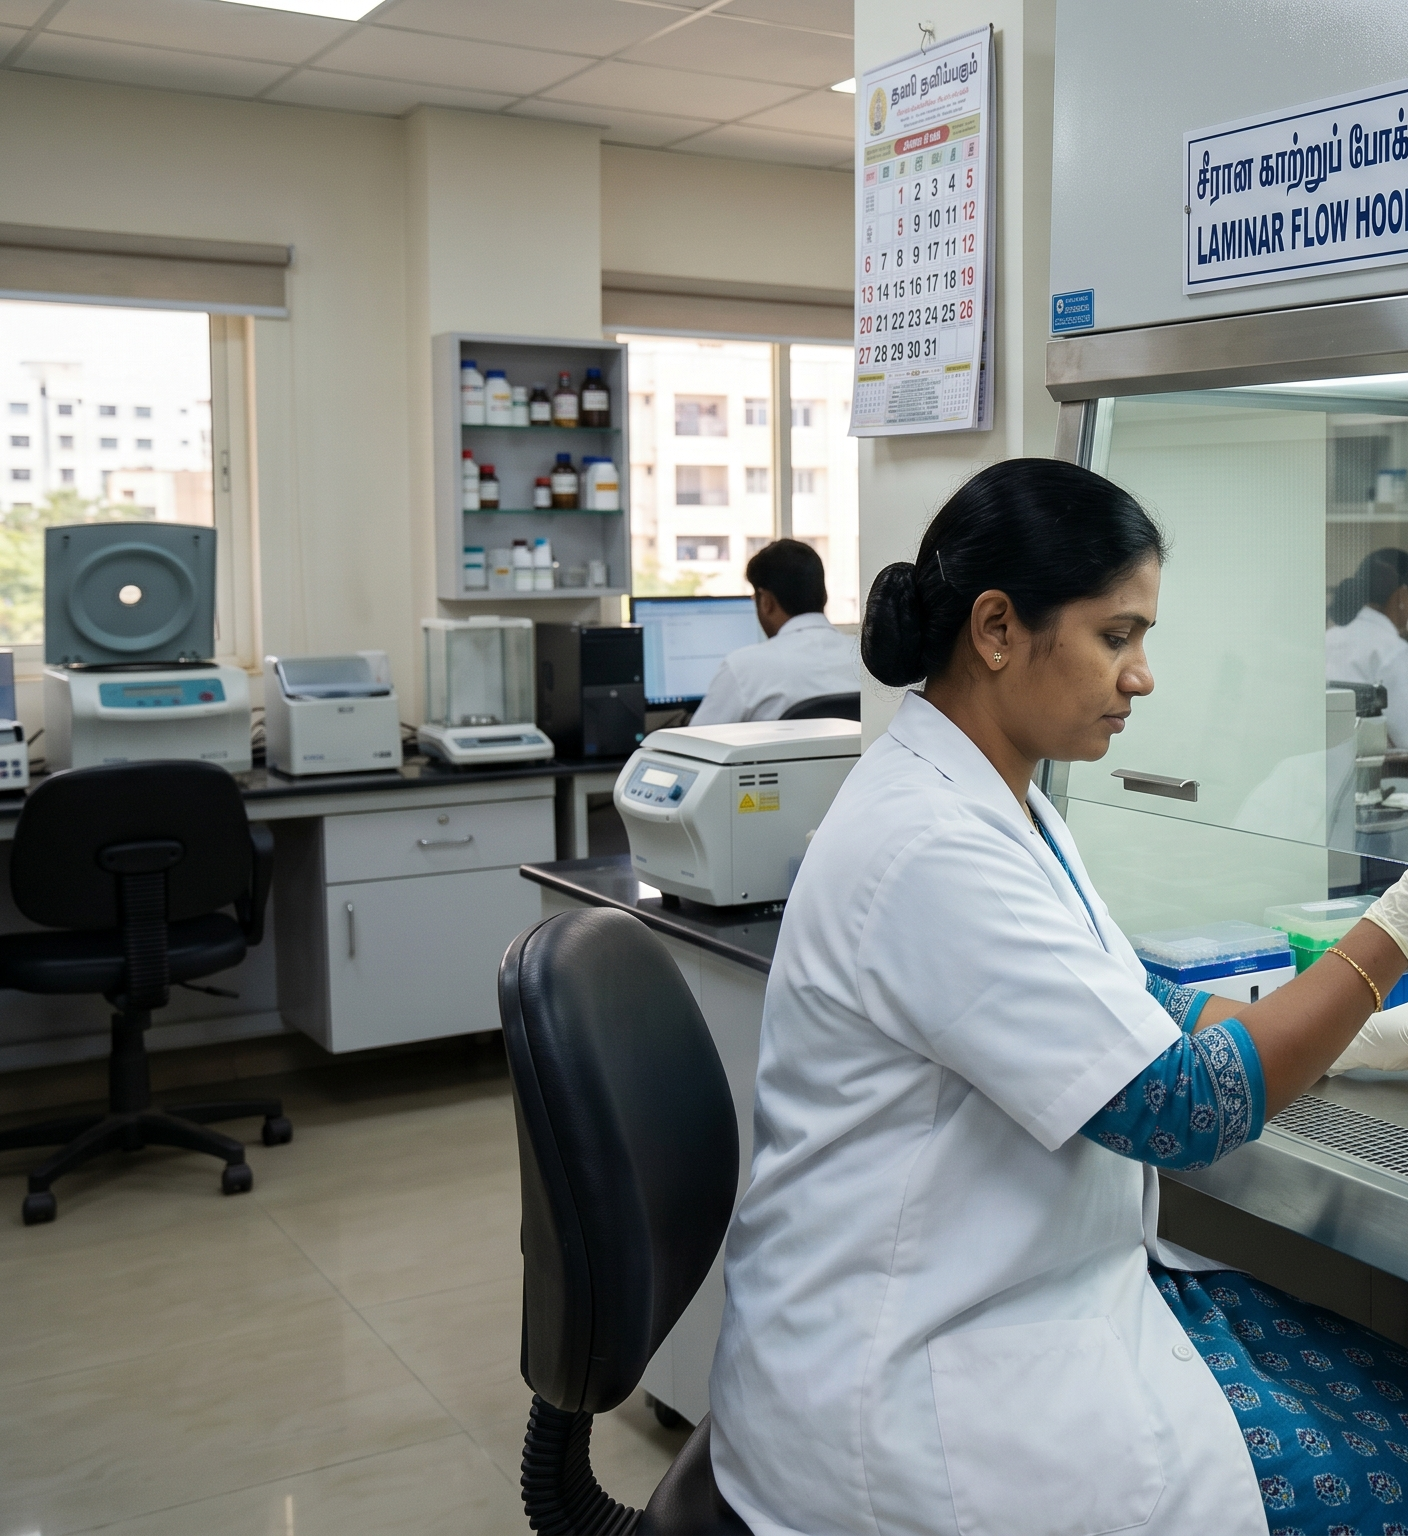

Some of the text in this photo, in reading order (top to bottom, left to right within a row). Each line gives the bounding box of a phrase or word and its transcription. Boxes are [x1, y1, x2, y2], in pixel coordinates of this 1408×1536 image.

[1197, 150, 1254, 207] சீரான
[1259, 122, 1342, 197] காற்றுப்
[898, 168, 973, 204] 1 2 3 4 5
[897, 200, 975, 236] 5 9 10 11 12
[1197, 211, 1285, 265] LAMINAR
[1291, 199, 1349, 250] FLOW
[865, 233, 974, 273] 6 7 8 9 17 11 12
[861, 266, 974, 304] 13 14 15 16 17 18 19
[860, 299, 973, 335] 20 21 22 23 24 25 26
[859, 337, 937, 365] 27 28 29 30 31
